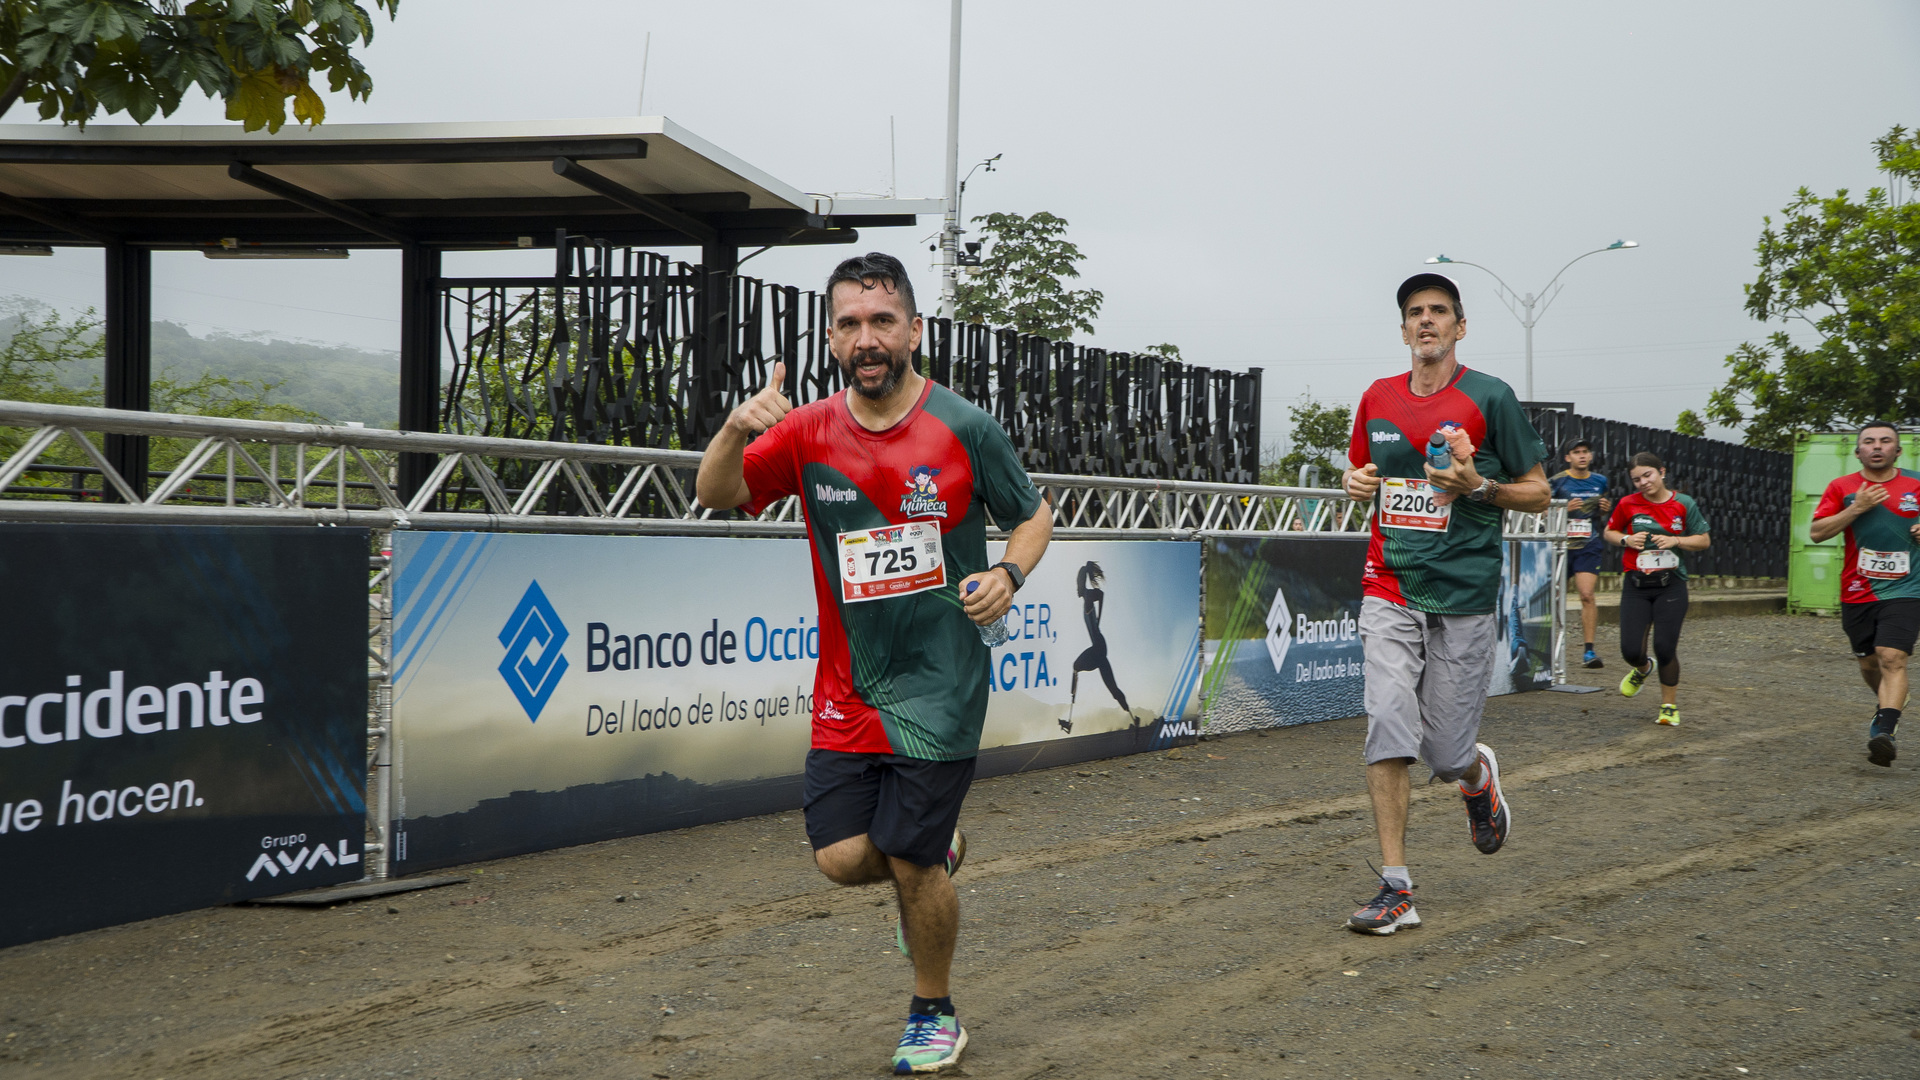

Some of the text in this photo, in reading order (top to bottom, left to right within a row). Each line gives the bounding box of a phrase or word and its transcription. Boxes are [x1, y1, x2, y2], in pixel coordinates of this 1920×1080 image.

[900, 499, 947, 516] Muñeca
[1392, 494, 1438, 514] 2206
[865, 546, 917, 576] 725
[1654, 558, 1660, 566] 1
[1870, 559, 1896, 571] 730
[1297, 611, 1357, 645] Banco de
[586, 622, 692, 672] Banco
[700, 618, 737, 665] de
[1296, 660, 1313, 682] Del
[1313, 659, 1334, 680] lado
[1334, 657, 1347, 677] de
[1347, 657, 1361, 677] los
[586, 700, 625, 737] Del
[632, 697, 682, 732] lado
[687, 693, 713, 726] de
[719, 691, 748, 722] los
[753, 694, 790, 726] que
[1160, 721, 1196, 738] AVAL
[57, 778, 205, 826] hacen.
[261, 833, 307, 849] Grupo
[245, 839, 359, 882] AVAL
